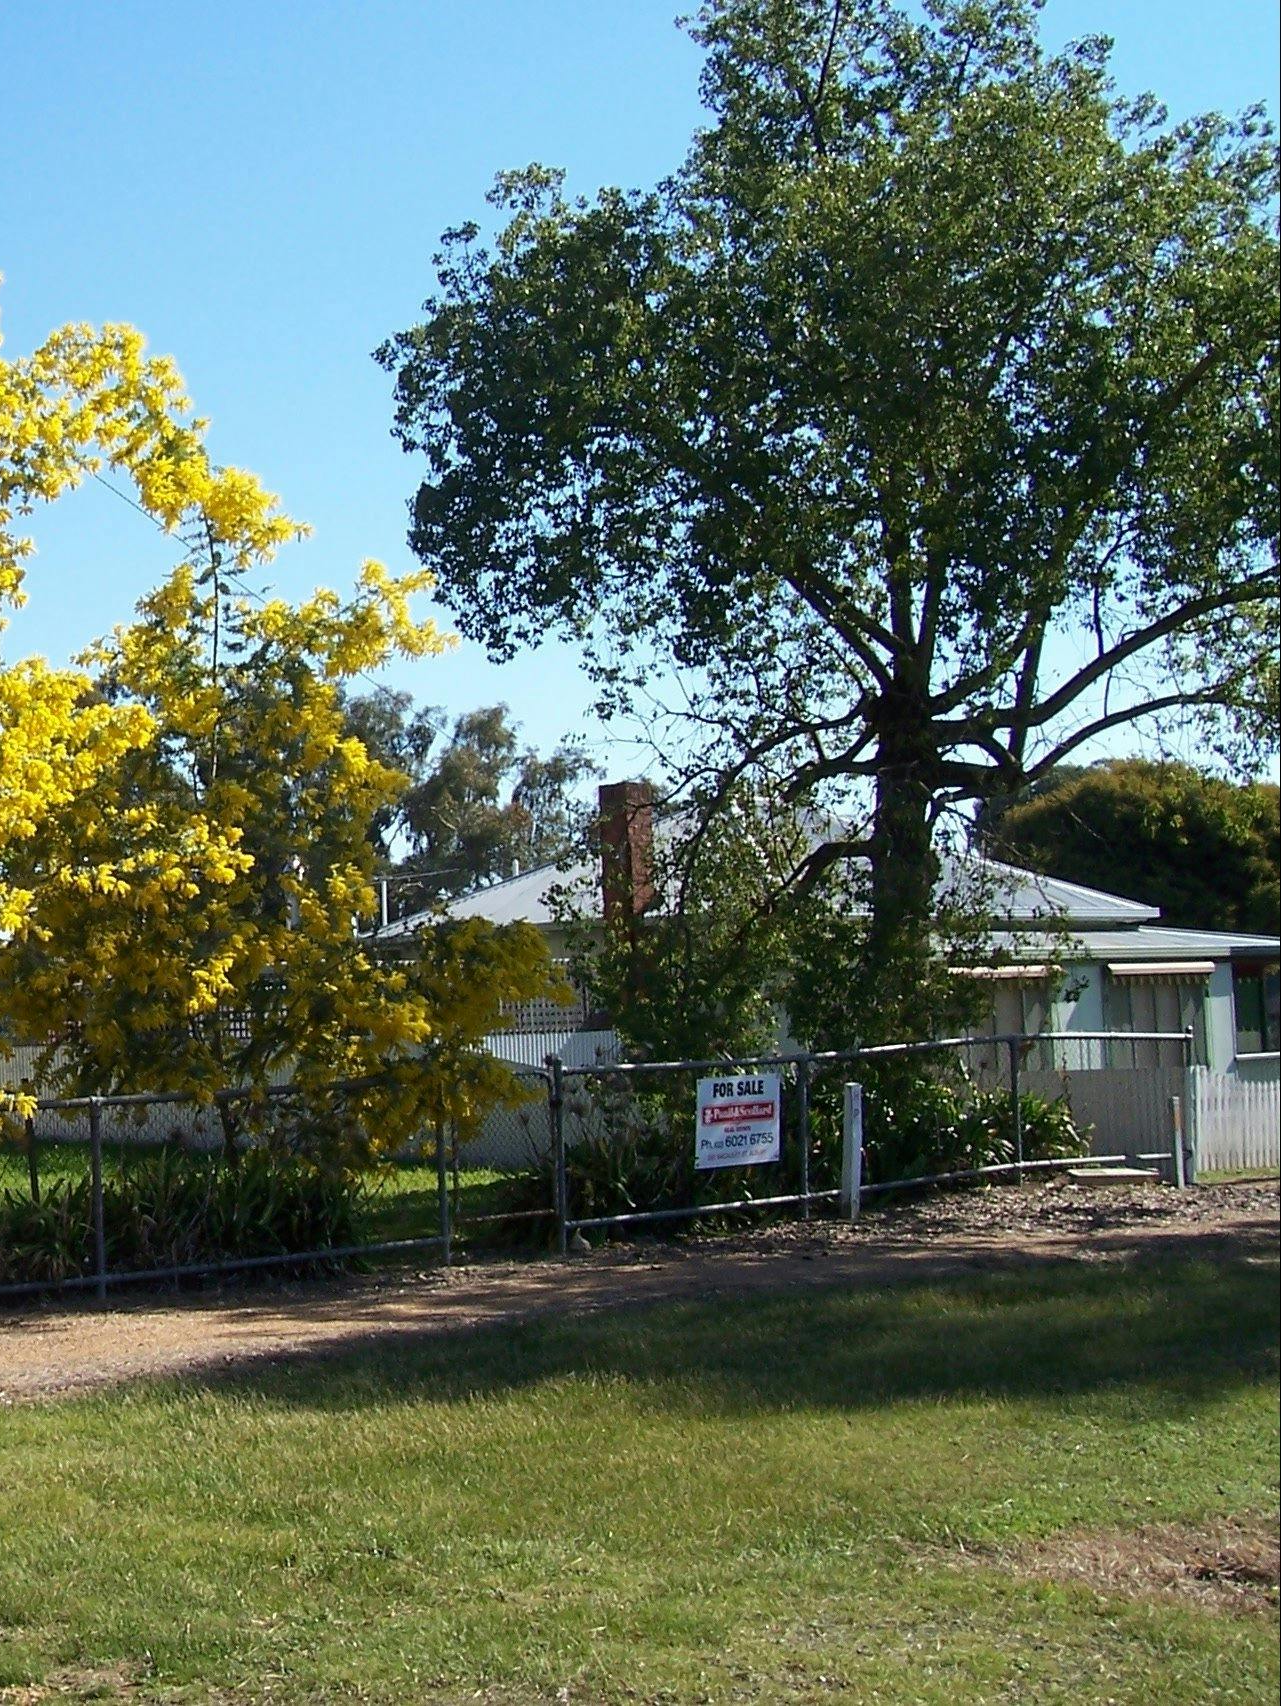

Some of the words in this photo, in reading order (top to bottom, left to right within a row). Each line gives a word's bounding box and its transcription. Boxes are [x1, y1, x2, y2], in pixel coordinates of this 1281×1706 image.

[713, 1082, 733, 1098] FOR
[737, 1080, 764, 1096] SALE
[725, 1134, 747, 1147] 6021
[750, 1132, 773, 1145] 6755
